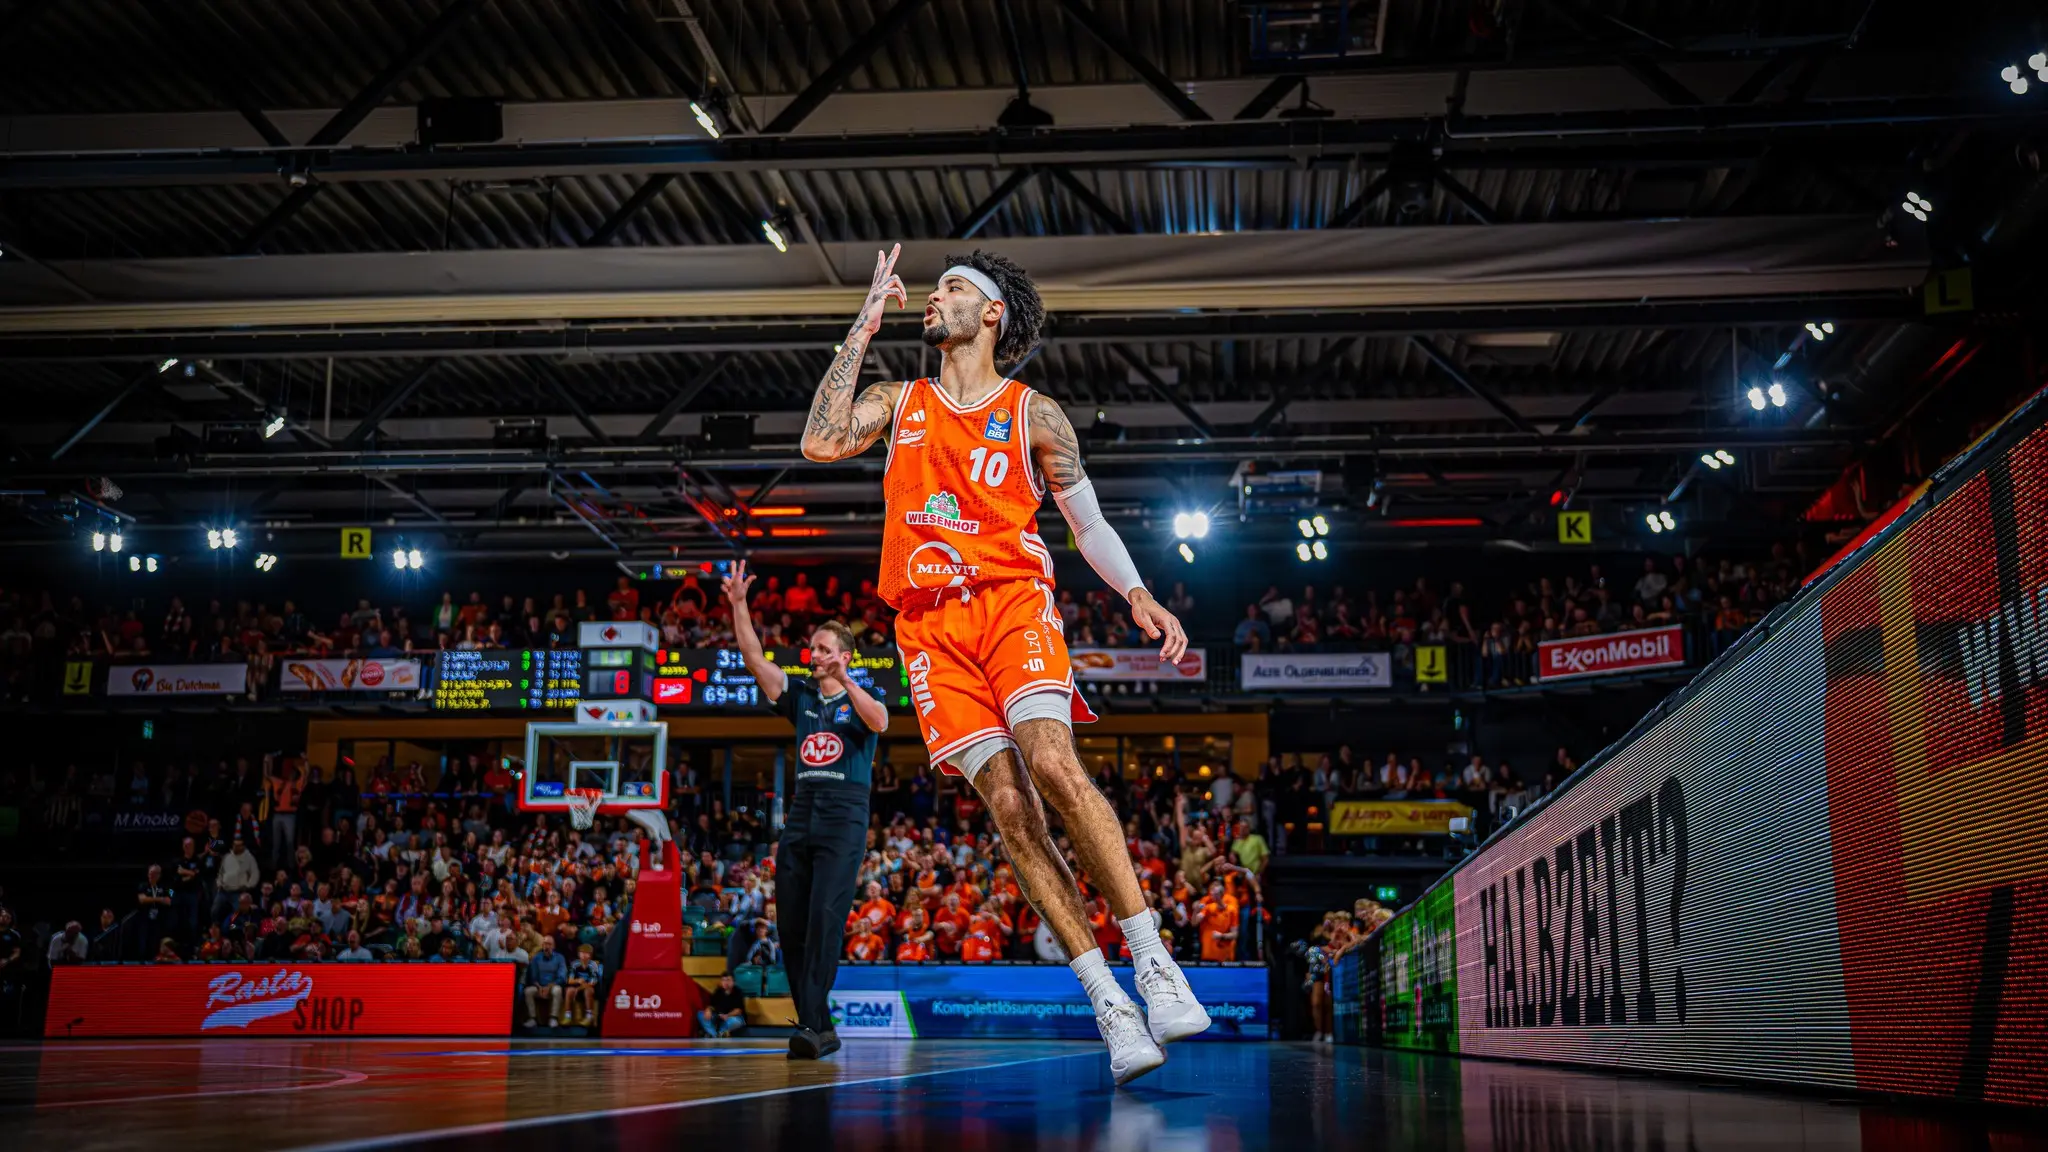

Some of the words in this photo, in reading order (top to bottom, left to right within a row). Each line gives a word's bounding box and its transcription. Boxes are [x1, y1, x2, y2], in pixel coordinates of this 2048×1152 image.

[1938, 273, 1961, 306] L
[987, 430, 1007, 440] BBL
[969, 447, 1009, 488] 10
[908, 513, 978, 533] WIESENHOF
[1566, 516, 1584, 538] K
[349, 532, 365, 554] R
[916, 563, 980, 576] MIAVIT
[1427, 650, 1436, 670] J
[1550, 634, 1670, 671] ExxonMobil
[702, 685, 758, 706] 69-61
[909, 656, 936, 717] VILSA
[606, 711, 634, 720] AIDA
[1480, 775, 1689, 1028] HALBZEIT?
[206, 968, 308, 1008] Rasta
[634, 994, 662, 1009] LzO
[846, 1002, 892, 1016] CAM
[932, 1001, 1063, 1019] Komplettlösungen
[292, 997, 364, 1031] SHOP
